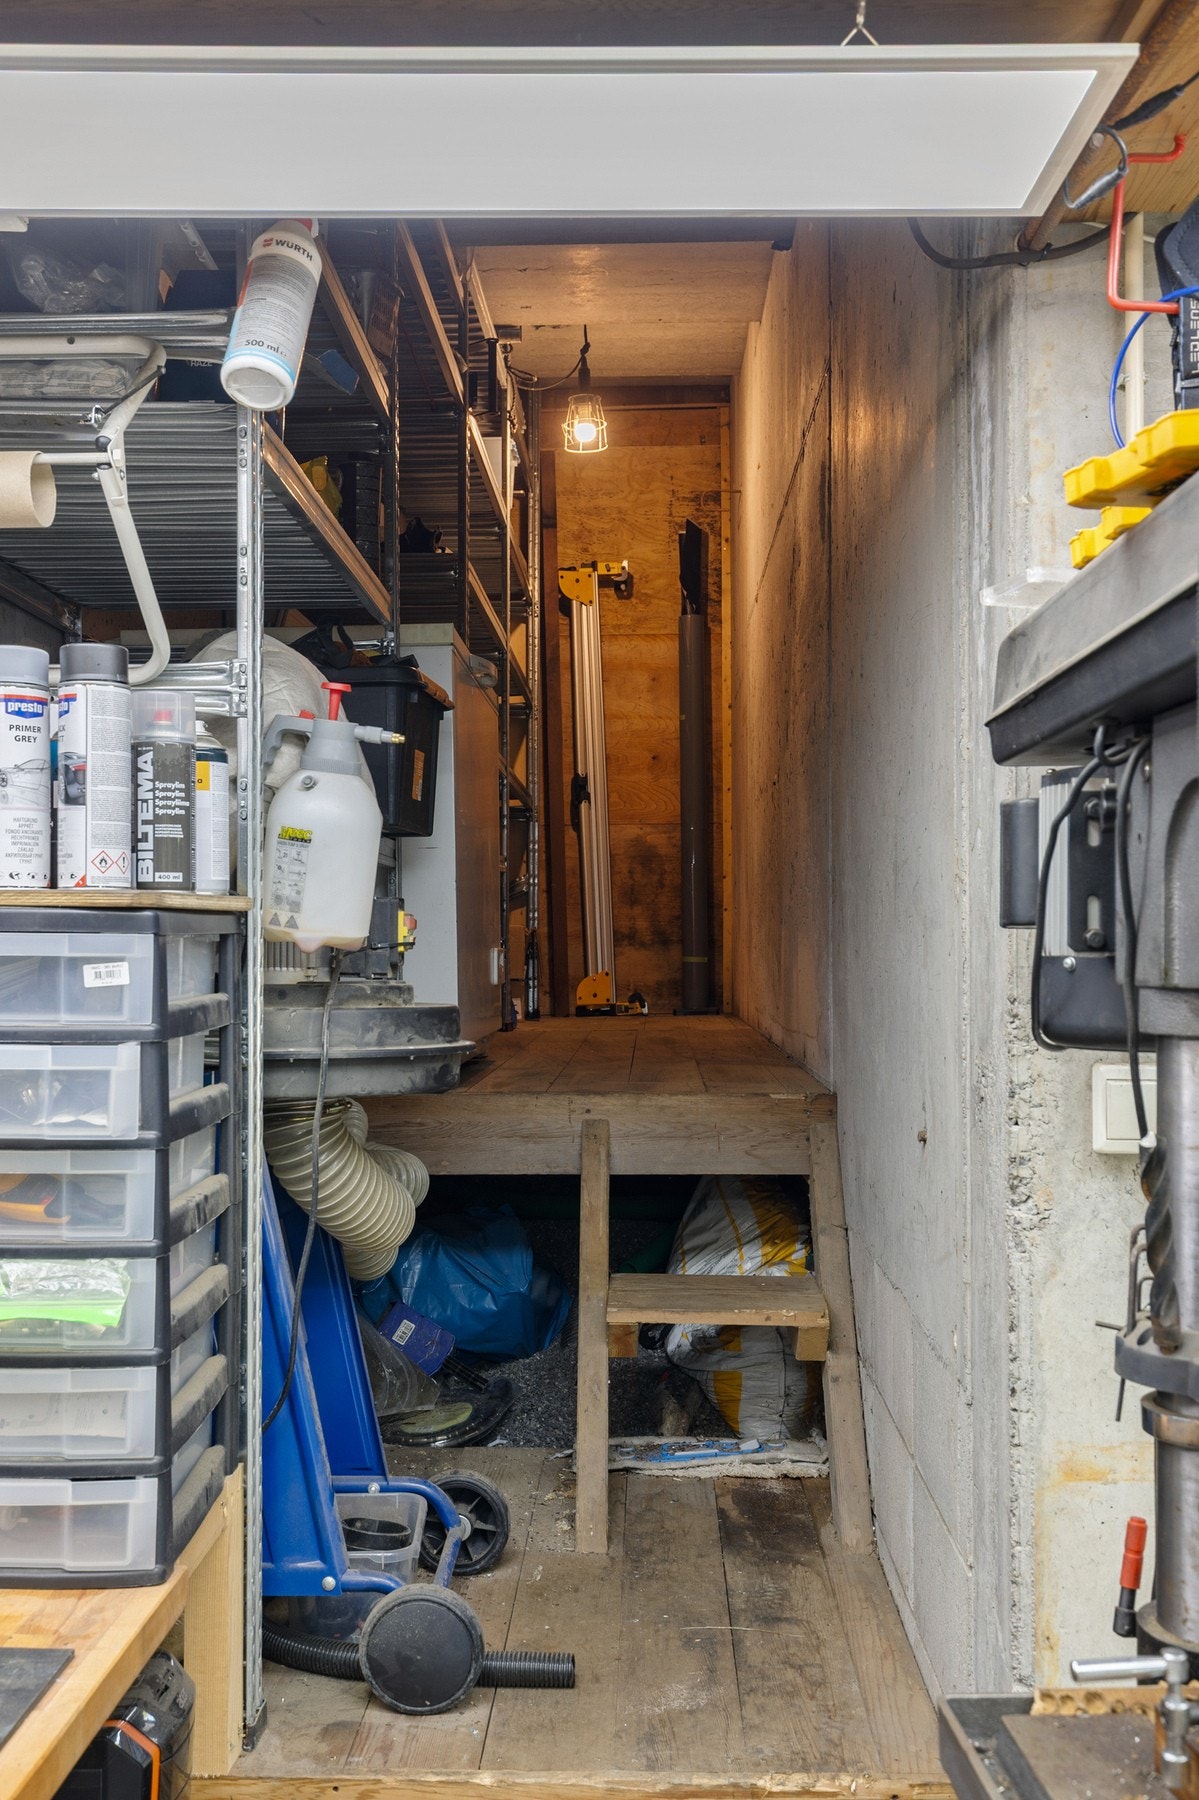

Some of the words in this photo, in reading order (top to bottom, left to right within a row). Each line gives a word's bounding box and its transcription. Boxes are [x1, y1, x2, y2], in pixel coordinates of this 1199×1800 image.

[275, 238, 313, 262] WÜRTH
[244, 339, 265, 347] 500
[266, 344, 280, 353] ml
[7, 701, 43, 714] presto
[9, 724, 42, 734] PRIMER
[14, 735, 38, 743] GREY
[154, 780, 185, 790] Spraylim
[154, 790, 185, 799] Spraylim
[137, 750, 154, 882] BILTEMA
[154, 807, 185, 816] Spraylim
